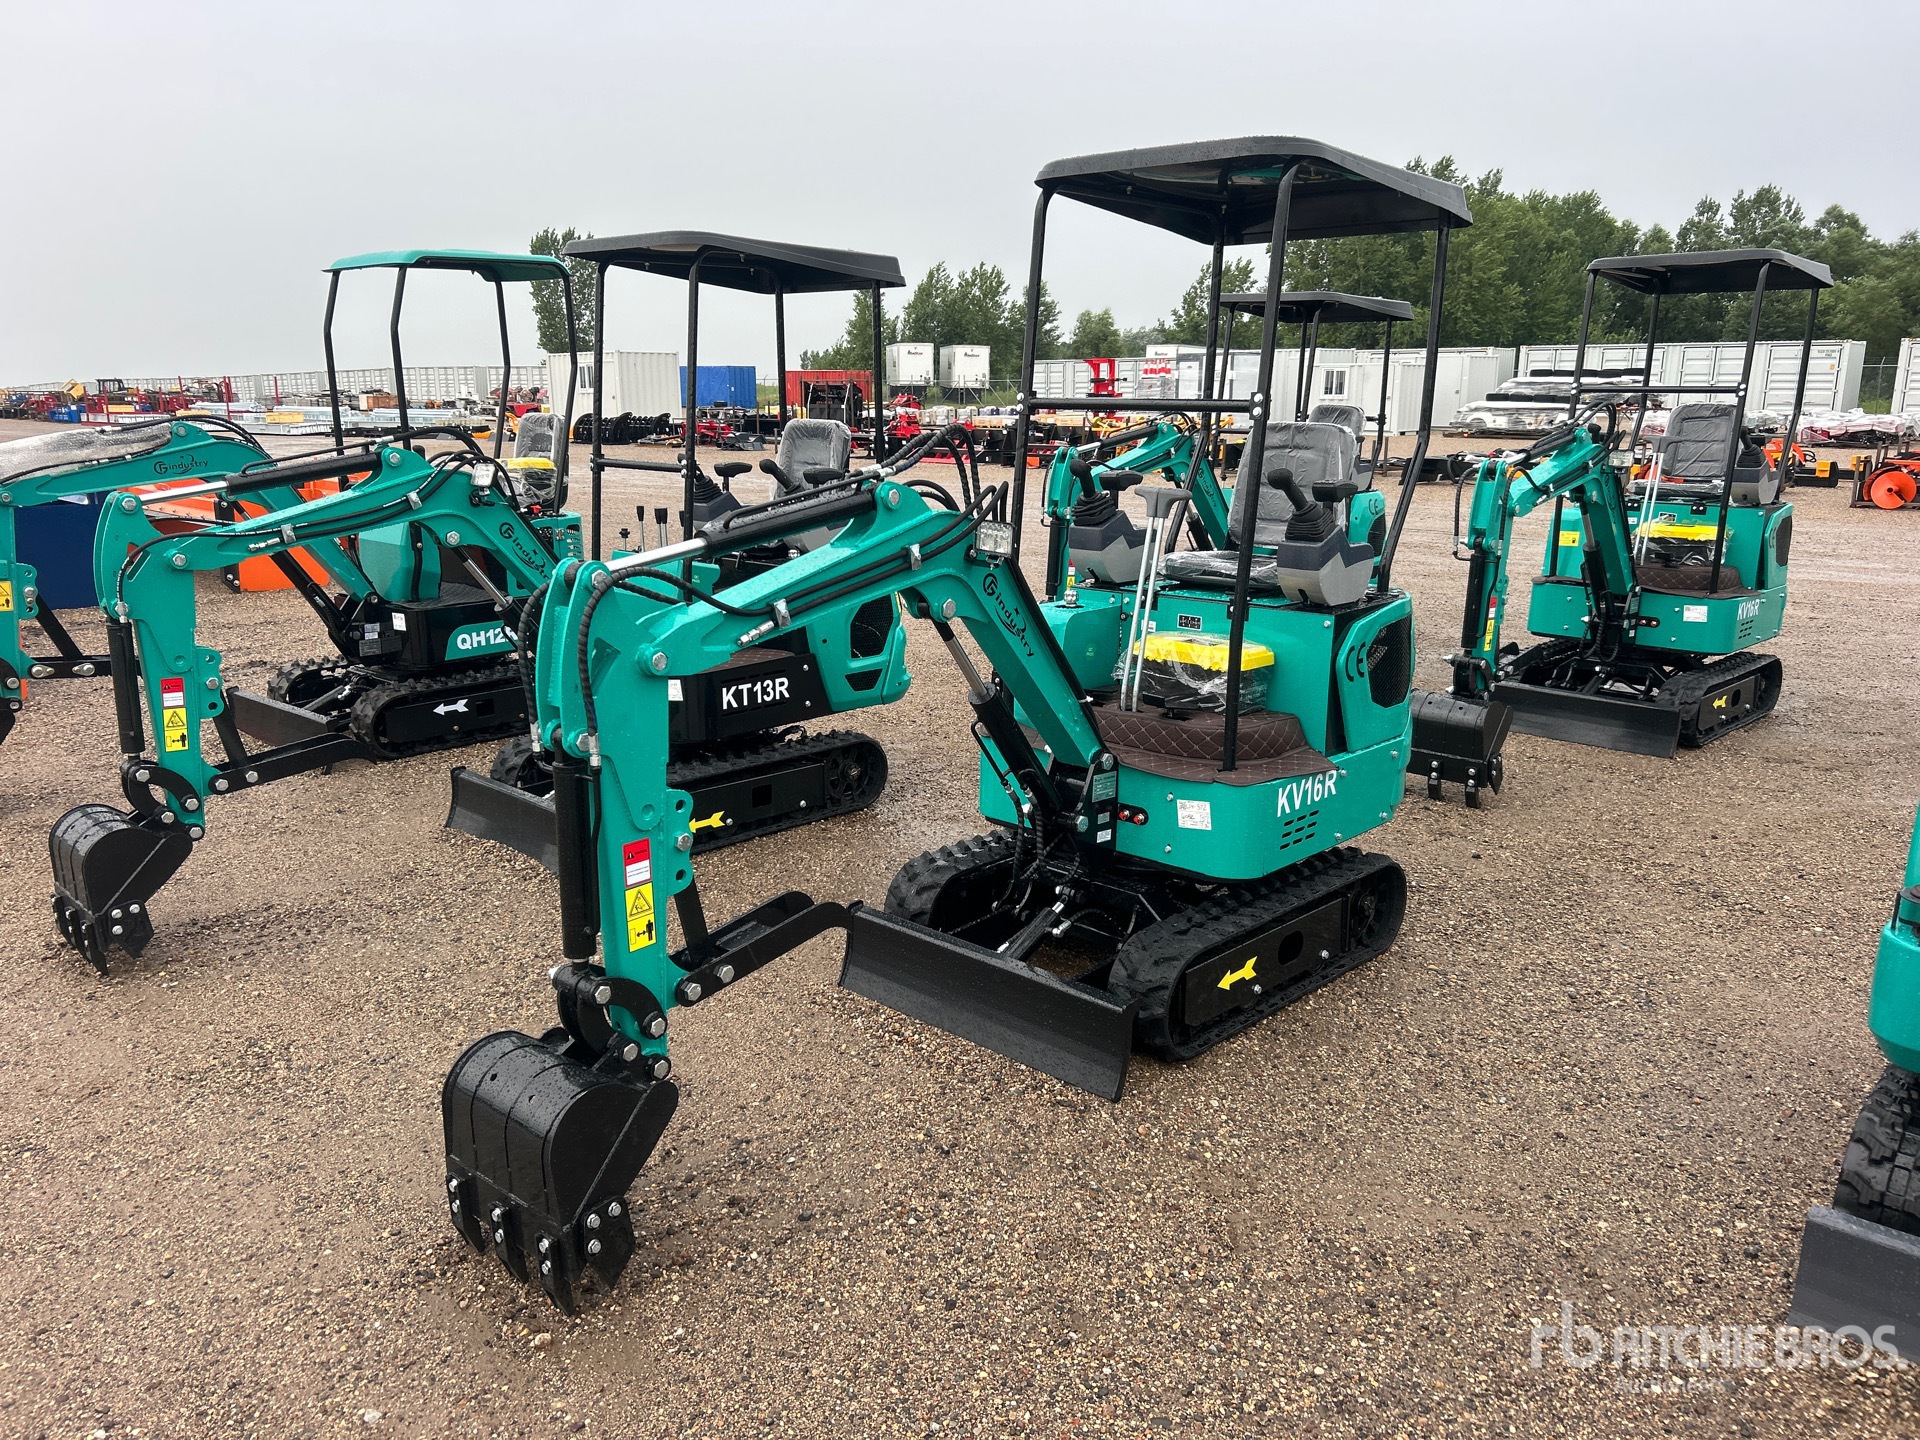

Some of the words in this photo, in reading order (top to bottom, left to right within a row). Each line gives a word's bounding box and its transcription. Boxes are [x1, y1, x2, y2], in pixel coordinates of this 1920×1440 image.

[1736, 598, 1761, 621] KV16R
[1345, 641, 1367, 682] CE
[721, 677, 790, 710] KT13R
[1276, 769, 1337, 818] KV16R
